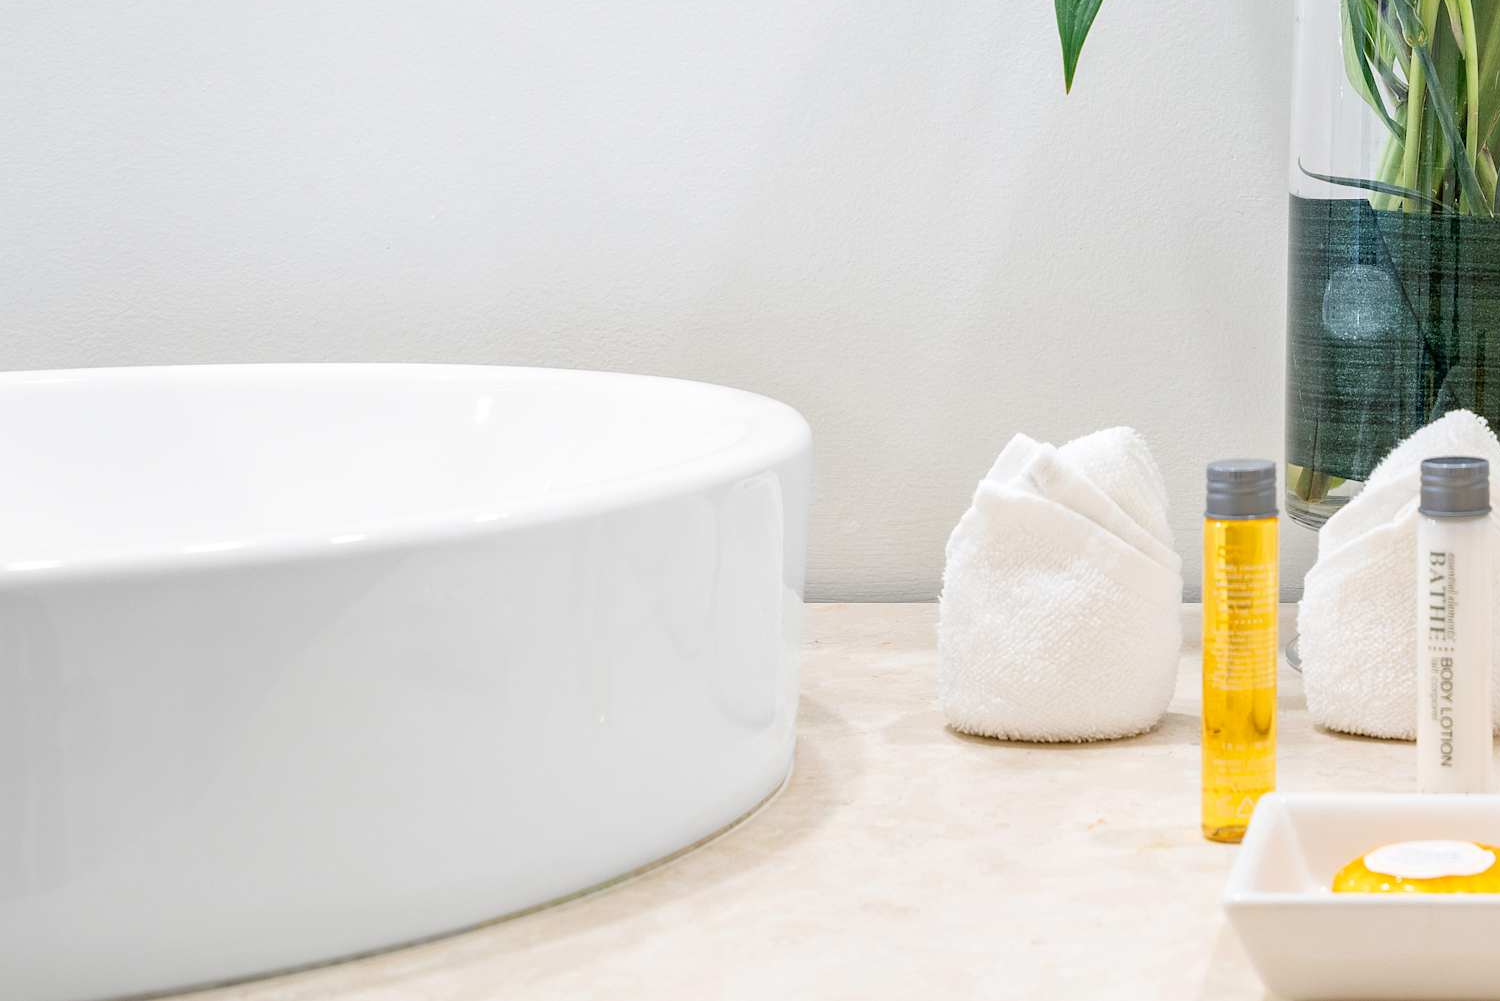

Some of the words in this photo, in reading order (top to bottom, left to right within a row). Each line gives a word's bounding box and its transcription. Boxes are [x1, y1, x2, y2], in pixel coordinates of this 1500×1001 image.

[1429, 551, 1446, 641] BATHE
[1440, 657, 1453, 702] BODY
[1440, 706, 1453, 768] LOTION
